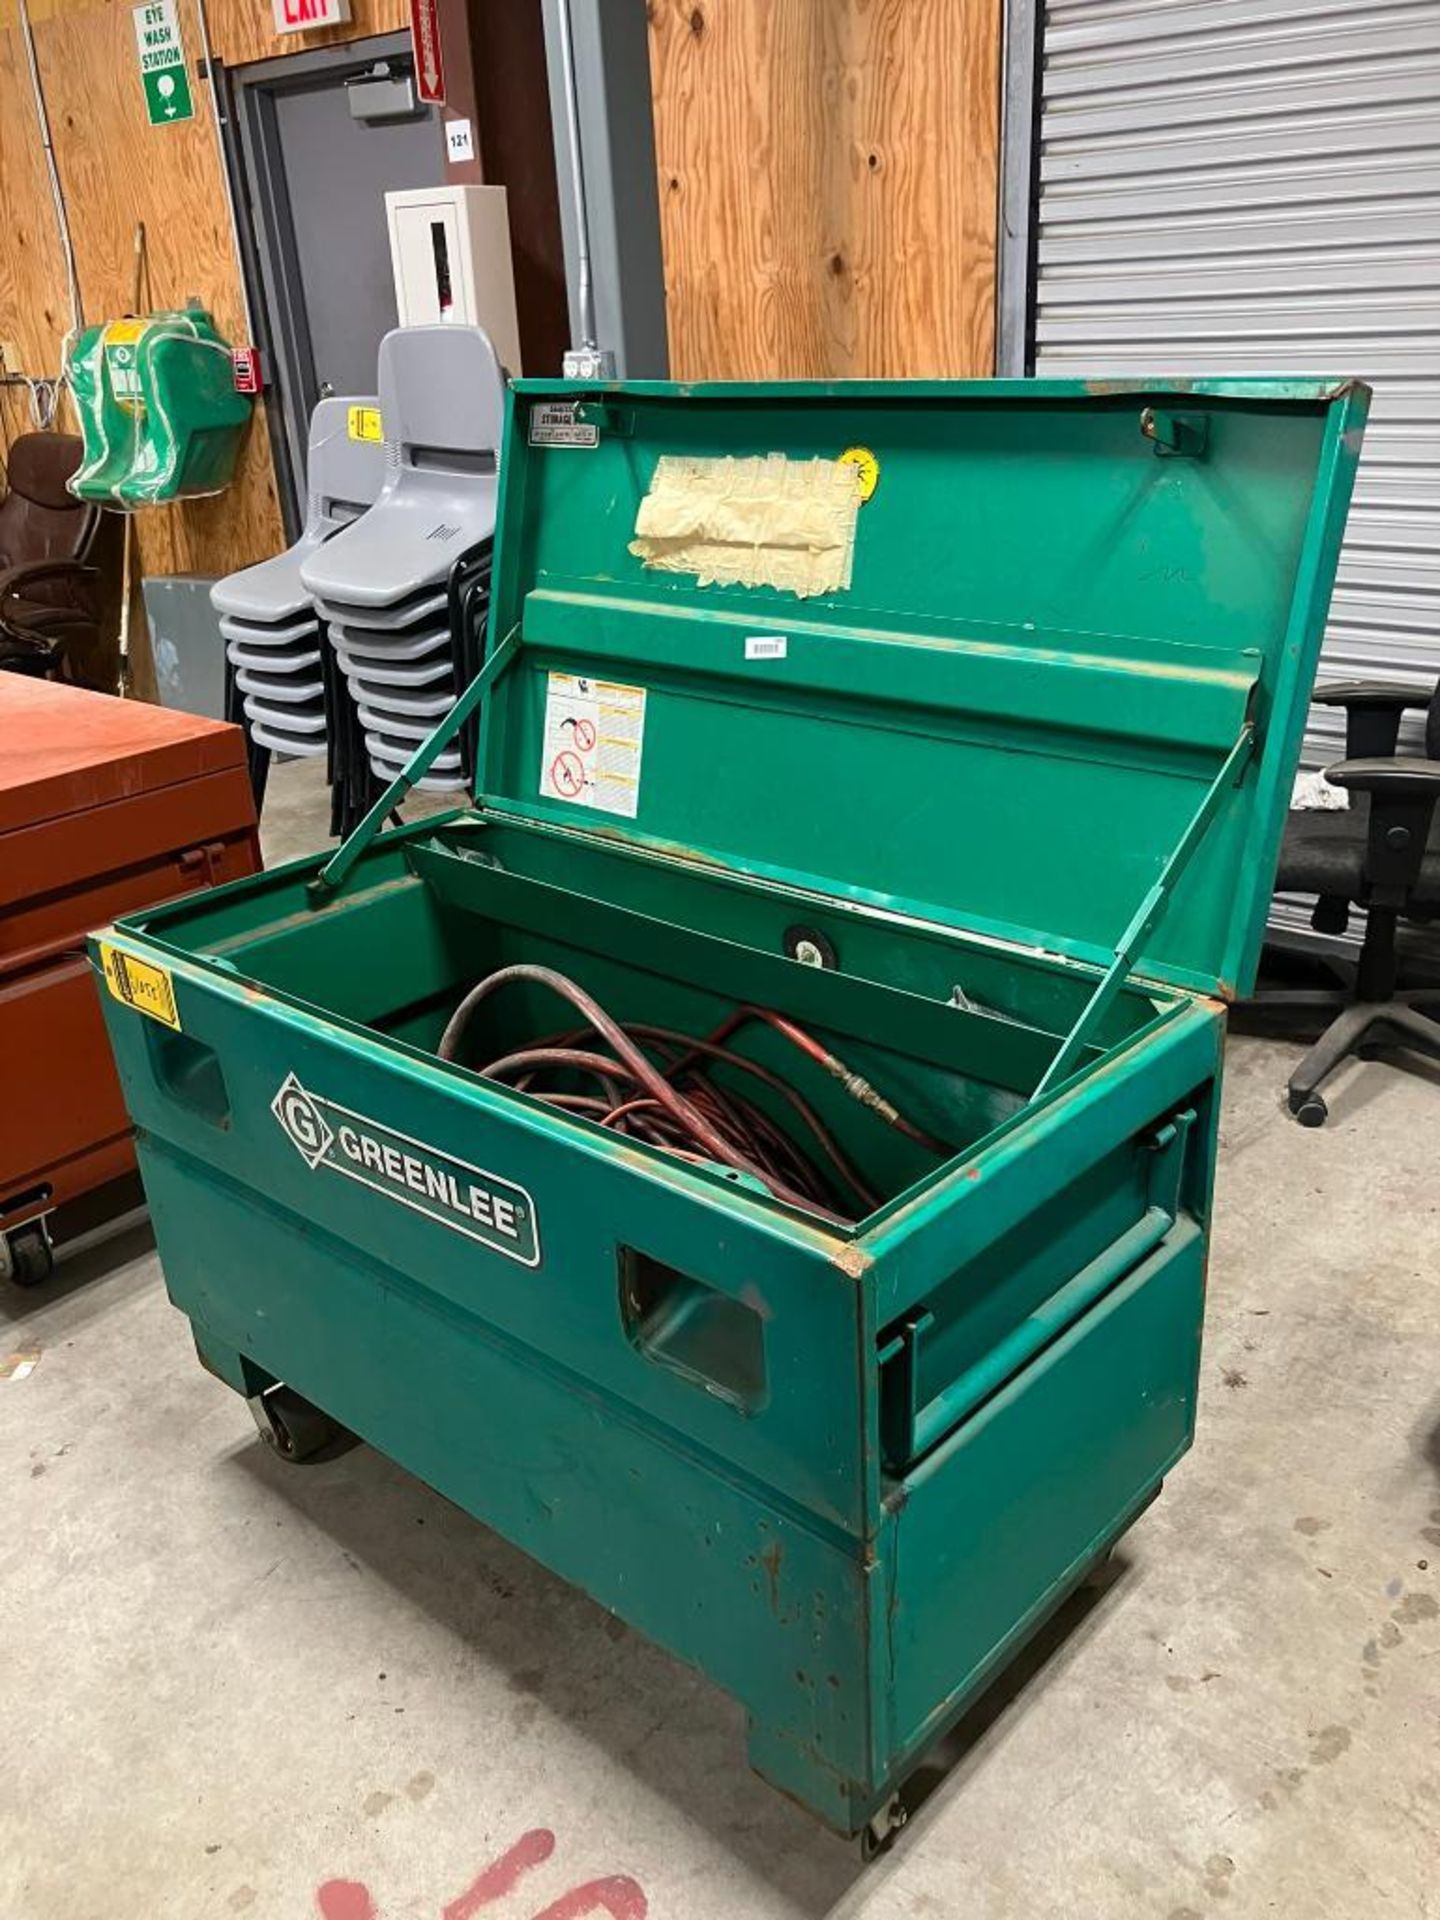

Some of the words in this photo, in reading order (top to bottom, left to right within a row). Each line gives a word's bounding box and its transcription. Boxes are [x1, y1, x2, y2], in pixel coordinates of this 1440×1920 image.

[145, 6, 163, 24] EYE
[144, 27, 171, 47] WASH
[142, 46, 180, 69] STATION
[338, 1126, 518, 1238] GREENLEE
